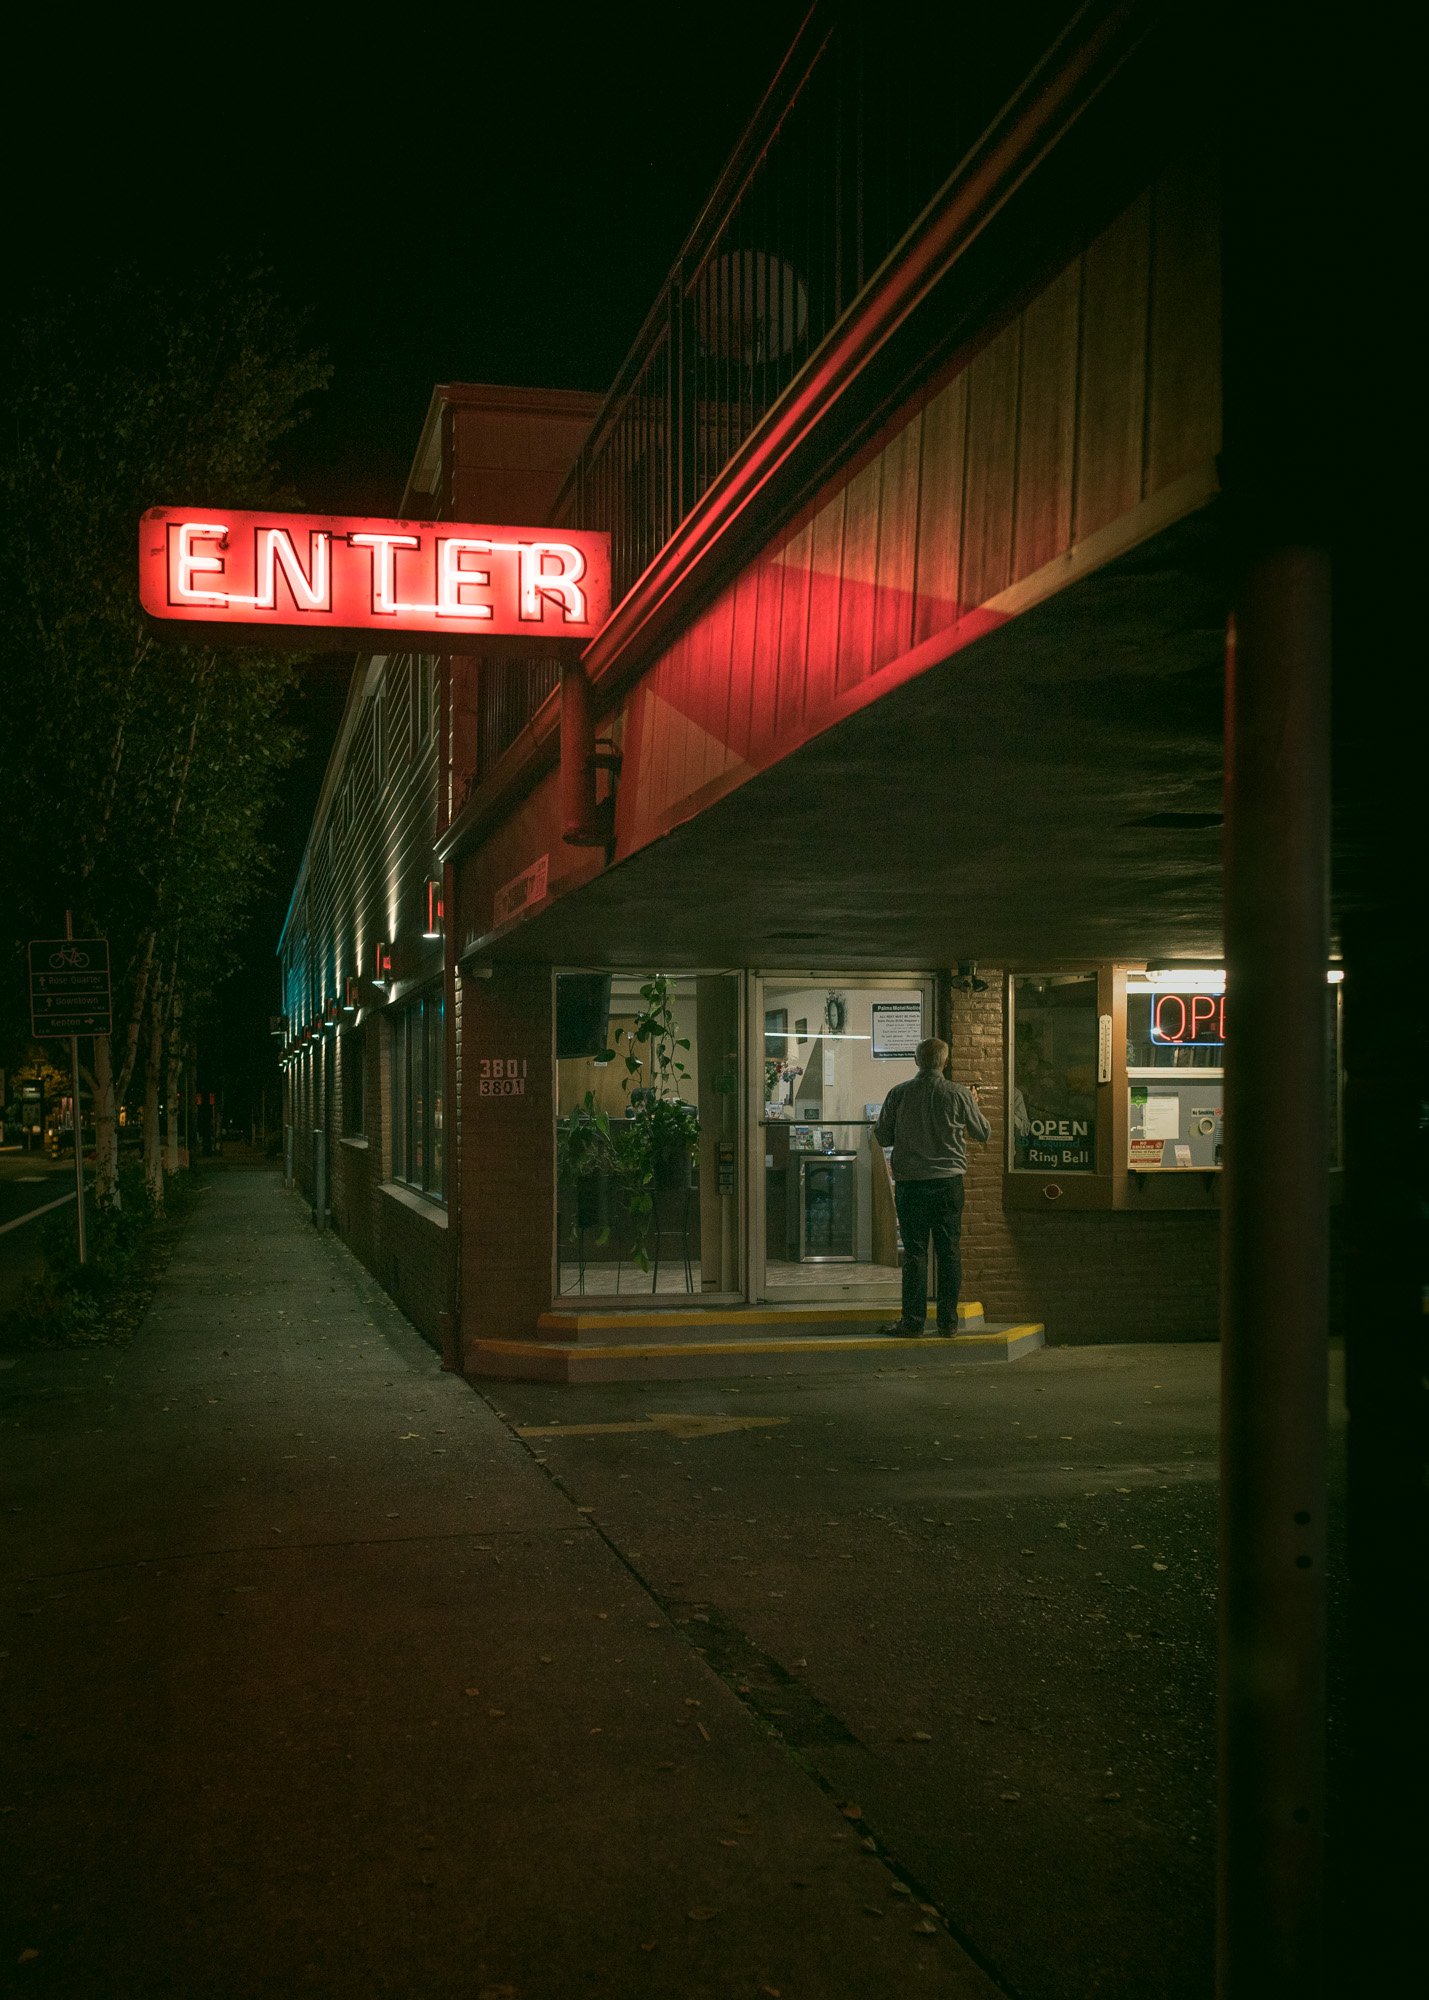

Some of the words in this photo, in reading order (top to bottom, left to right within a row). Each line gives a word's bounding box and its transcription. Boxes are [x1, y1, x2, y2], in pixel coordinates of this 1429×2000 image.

[166, 521, 590, 625] ENTER
[1156, 995, 1226, 1041] OP
[480, 1059, 527, 1078] 3801
[481, 1080, 522, 1095] 3801
[1030, 1120, 1088, 1136] OPEN
[1029, 1149, 1058, 1167] Ring
[1062, 1150, 1088, 1163] Bell
